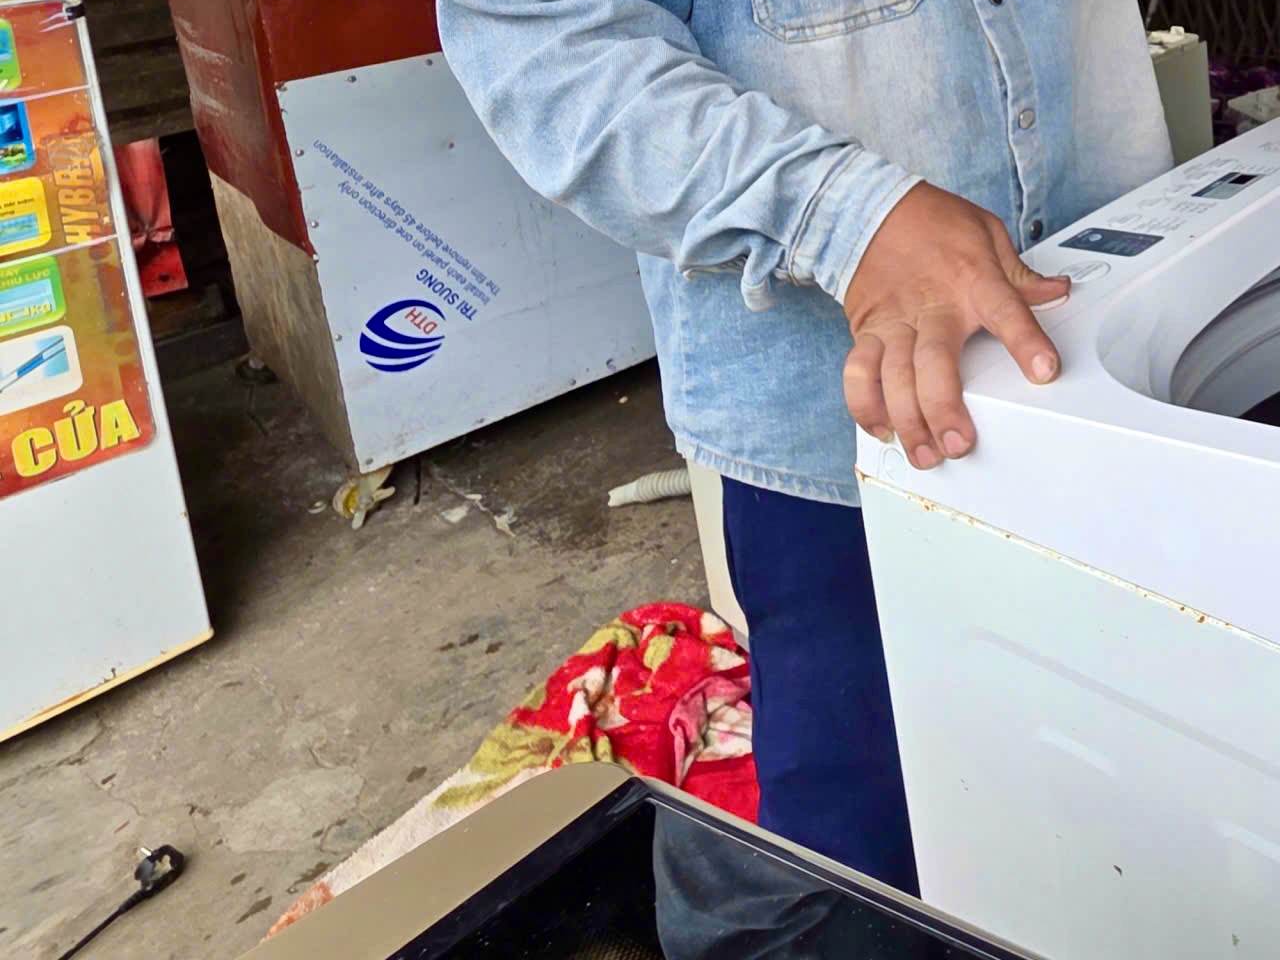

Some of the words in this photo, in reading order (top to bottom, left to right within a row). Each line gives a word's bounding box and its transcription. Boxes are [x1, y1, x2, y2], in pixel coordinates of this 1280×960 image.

[312, 139, 364, 186] installation
[337, 180, 360, 200] only
[361, 180, 385, 199] after
[358, 196, 398, 230] direction
[383, 196, 406, 217] days
[402, 213, 416, 227] 45
[395, 225, 414, 243] one
[415, 223, 443, 250] before
[412, 239, 426, 253] on
[441, 243, 472, 271] remove
[421, 248, 450, 270] panel
[446, 266, 467, 285] each
[416, 268, 459, 306] SUONG
[485, 279, 501, 297] The
[404, 306, 438, 336] DTH
[456, 299, 478, 321] TRI
[12, 399, 141, 477] CỬA
